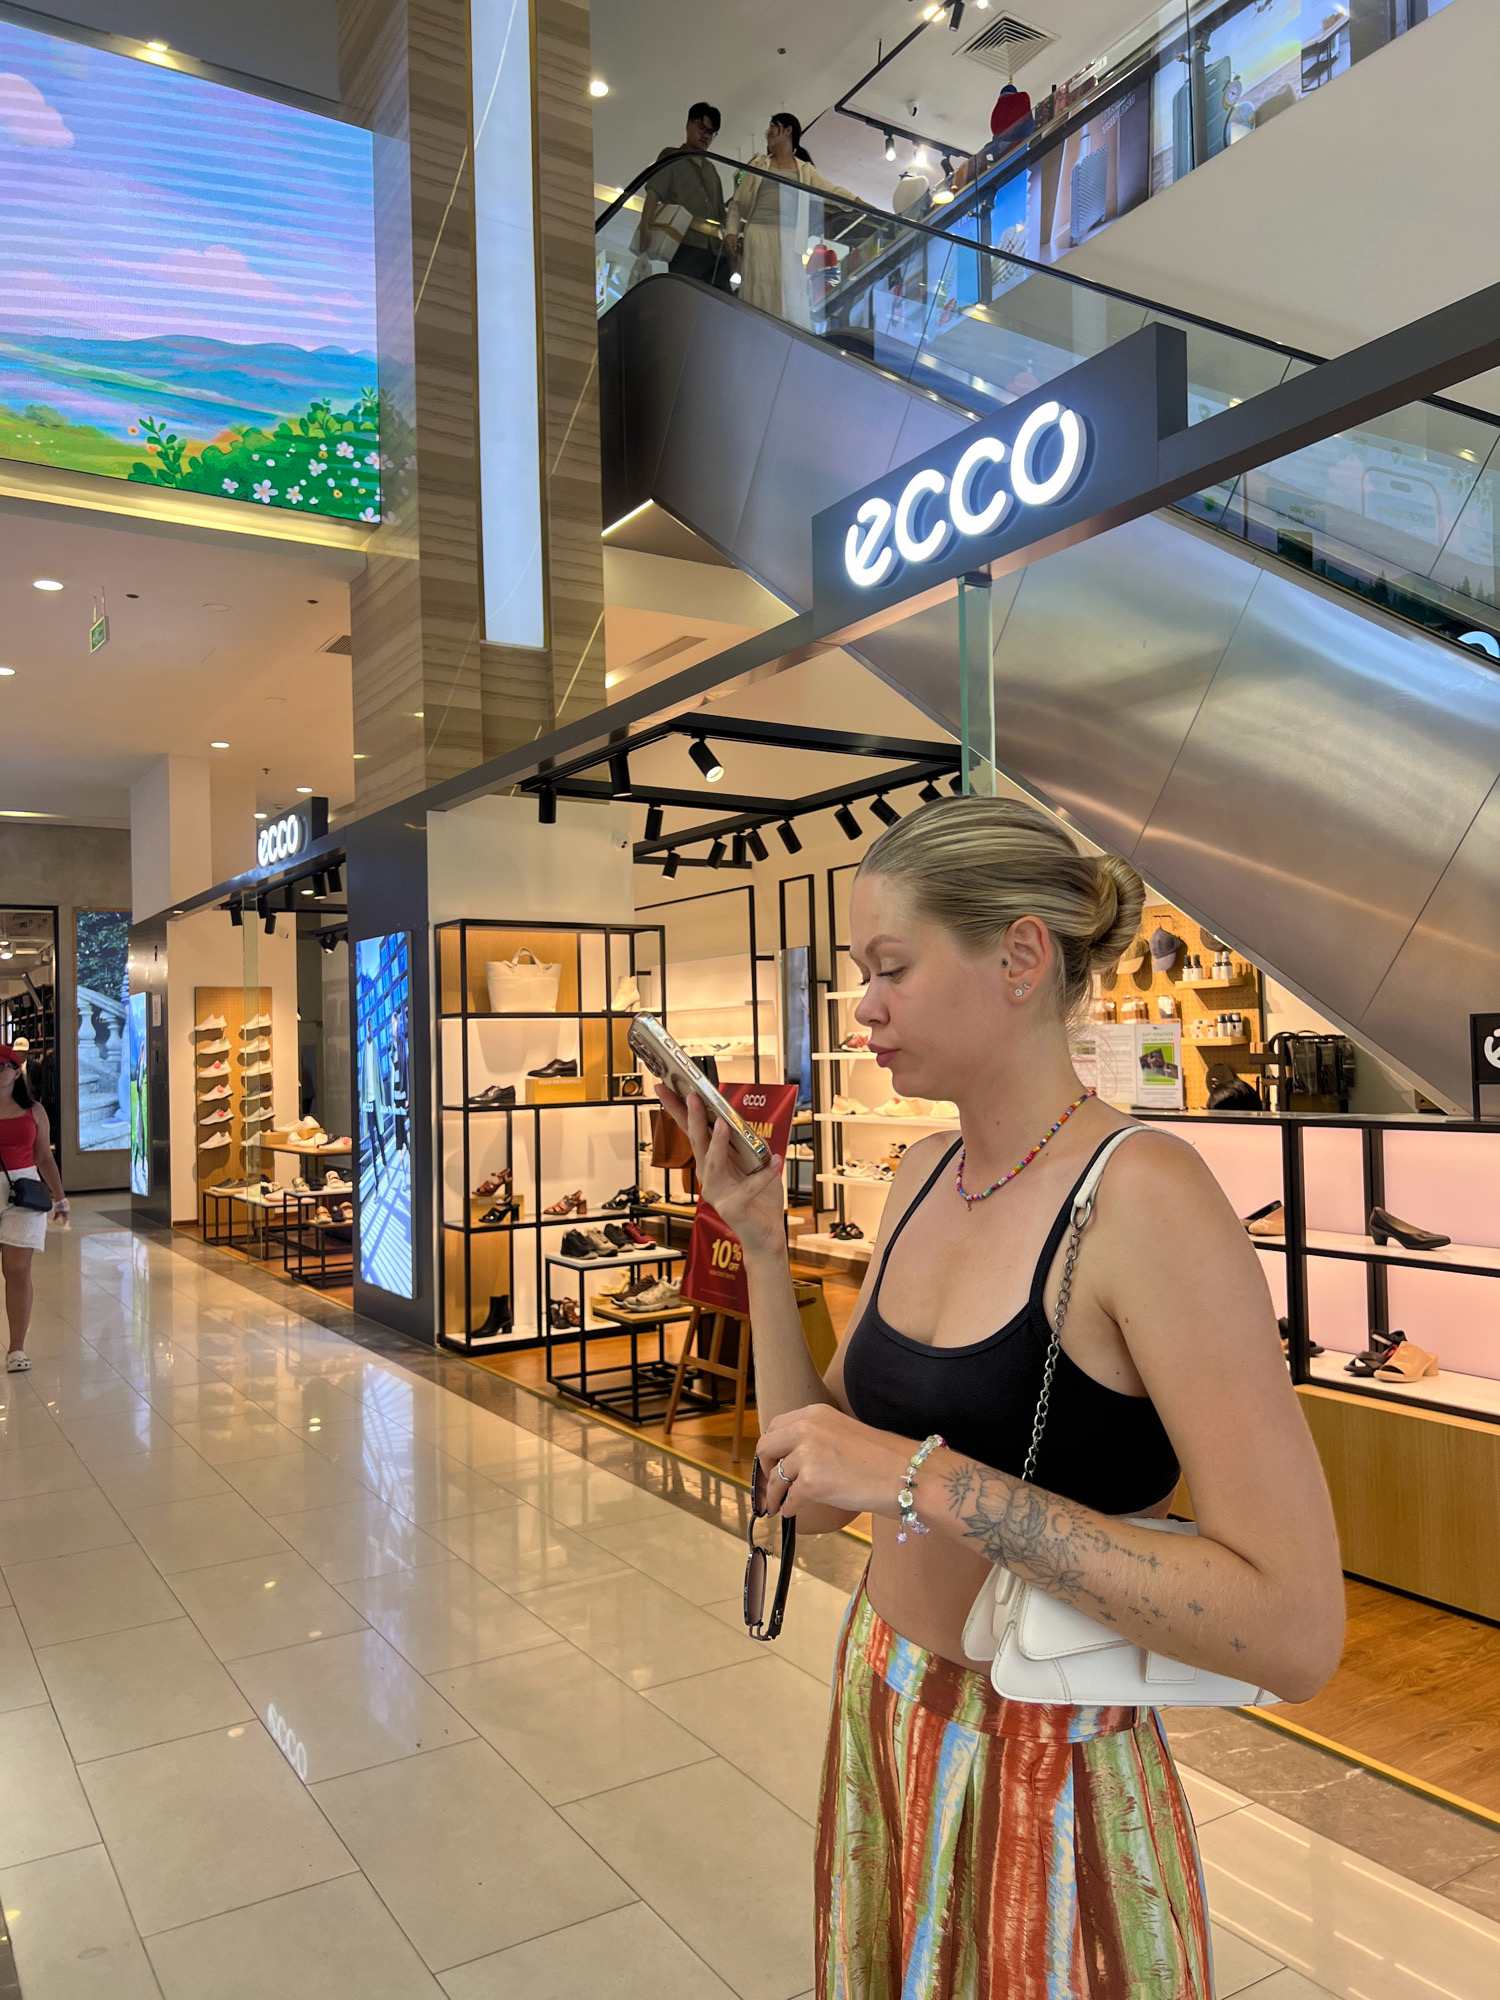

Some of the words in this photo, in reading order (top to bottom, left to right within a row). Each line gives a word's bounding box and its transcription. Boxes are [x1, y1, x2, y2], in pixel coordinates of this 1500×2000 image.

[844, 401, 1090, 587] ecco
[258, 814, 300, 867] ecco
[743, 1094, 767, 1107] ecco
[711, 1238, 743, 1269] 10%
